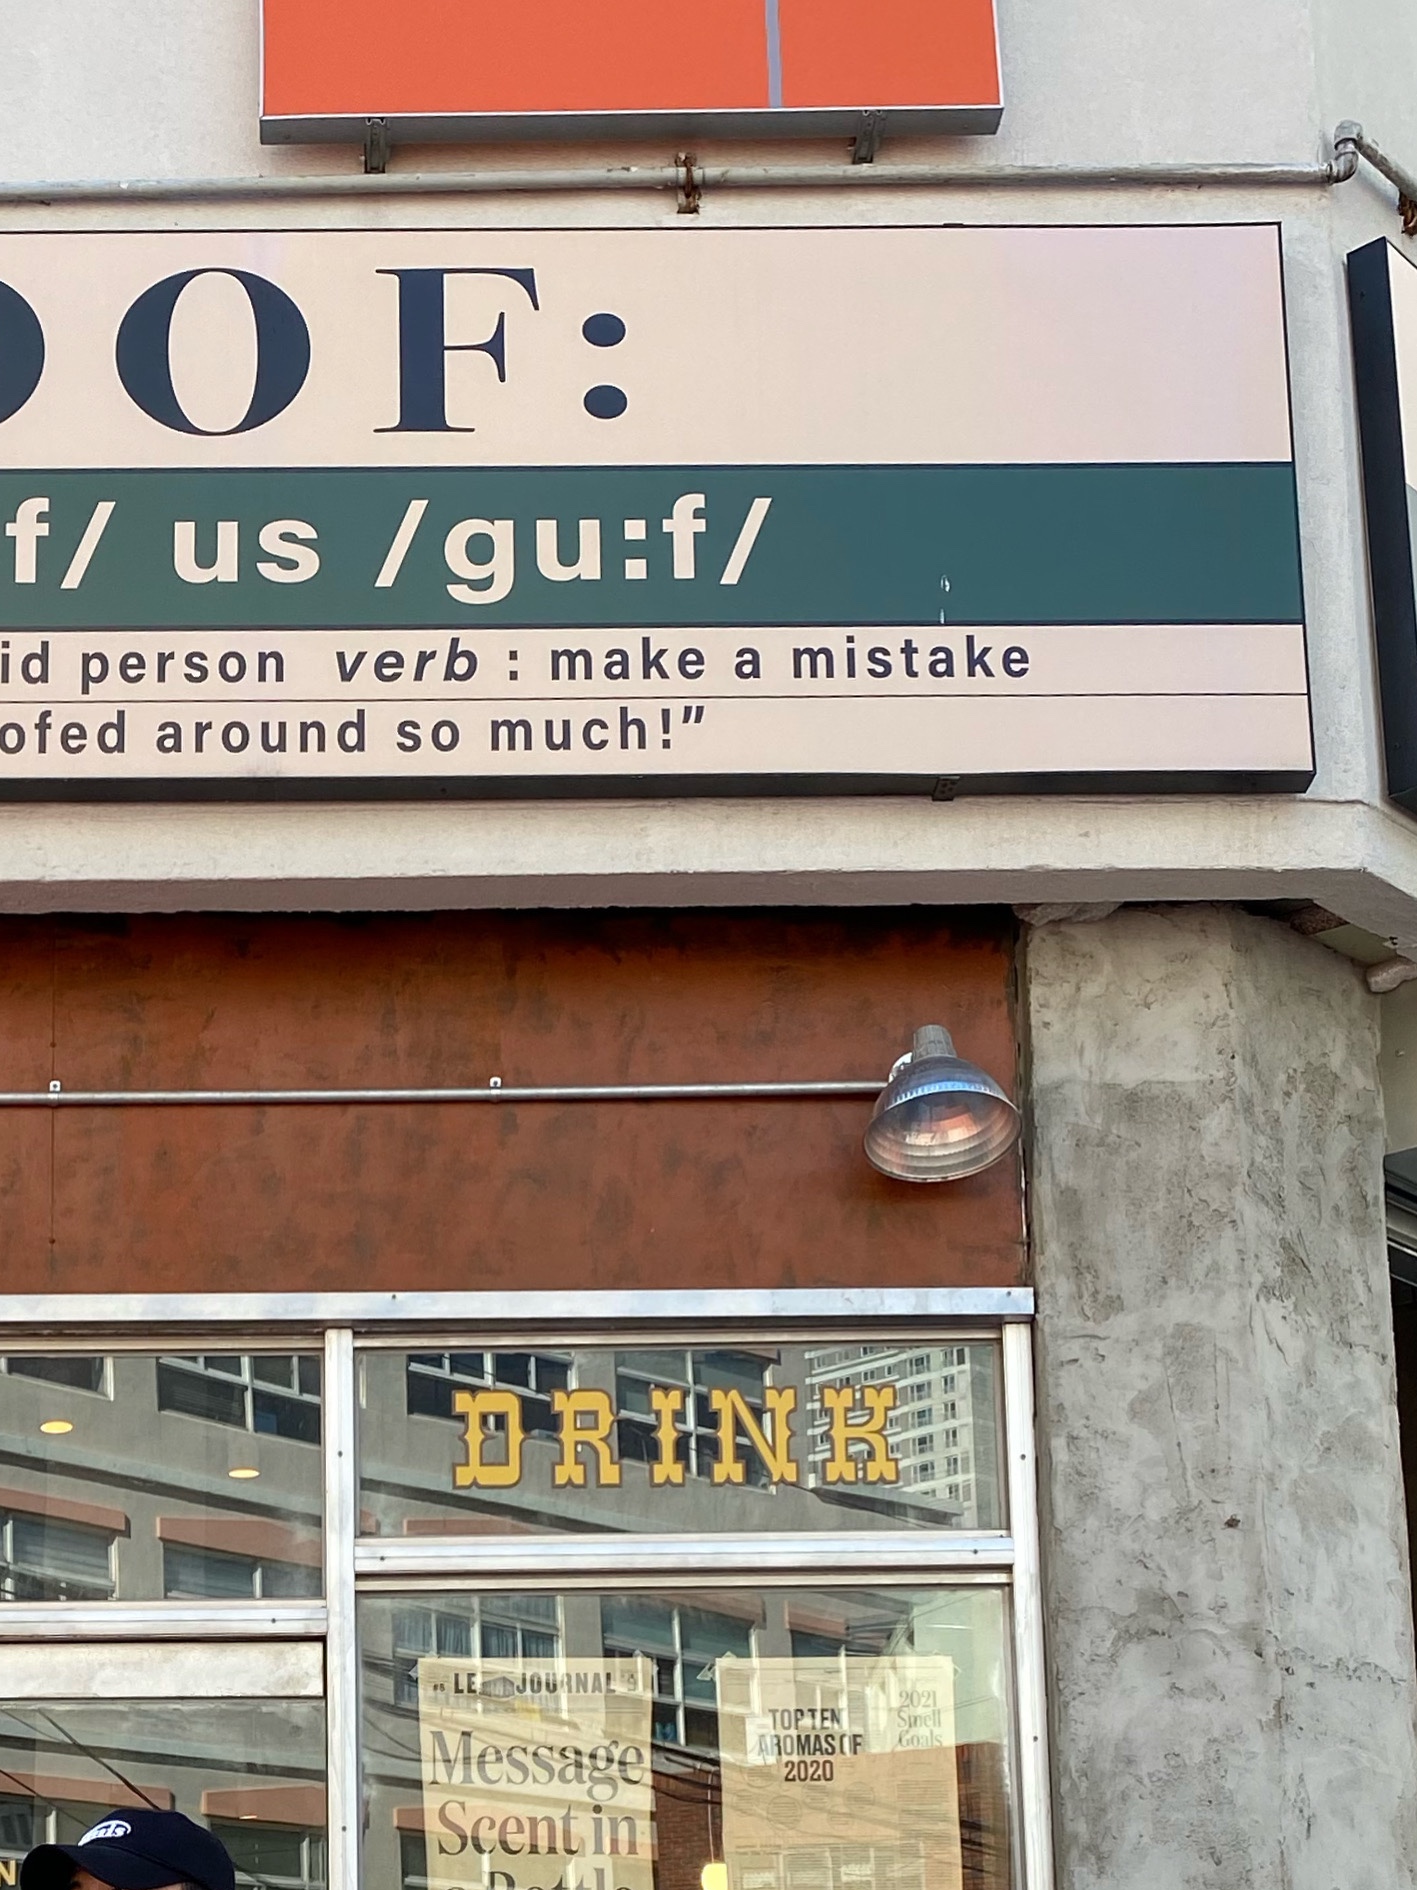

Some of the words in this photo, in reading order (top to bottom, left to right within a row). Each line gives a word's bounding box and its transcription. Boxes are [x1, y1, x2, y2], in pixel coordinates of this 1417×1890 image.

[174, 520, 320, 584] us
[374, 494, 773, 604] /gu:f/
[81, 651, 284, 696] person
[335, 637, 478, 683] verb
[550, 637, 705, 681] make
[734, 647, 761, 680] a
[792, 634, 1030, 679] mistake
[156, 708, 367, 754] around
[396, 719, 460, 753] so
[490, 705, 705, 752] much!”
[451, 1385, 901, 1488] DRINK
[453, 1672, 478, 1695] LE
[515, 1671, 616, 1695] JOURNAL
[898, 1689, 938, 1709] 2021
[769, 1708, 805, 1731] TOP
[809, 1707, 842, 1730] TEN
[897, 1709, 942, 1729] Smell
[757, 1733, 835, 1756] AROMAS
[839, 1733, 863, 1756] OF
[897, 1728, 943, 1748] Goals
[428, 1729, 646, 1801] Message
[783, 1759, 834, 1782] 2020
[437, 1799, 583, 1856] Scent
[591, 1803, 640, 1856] in
